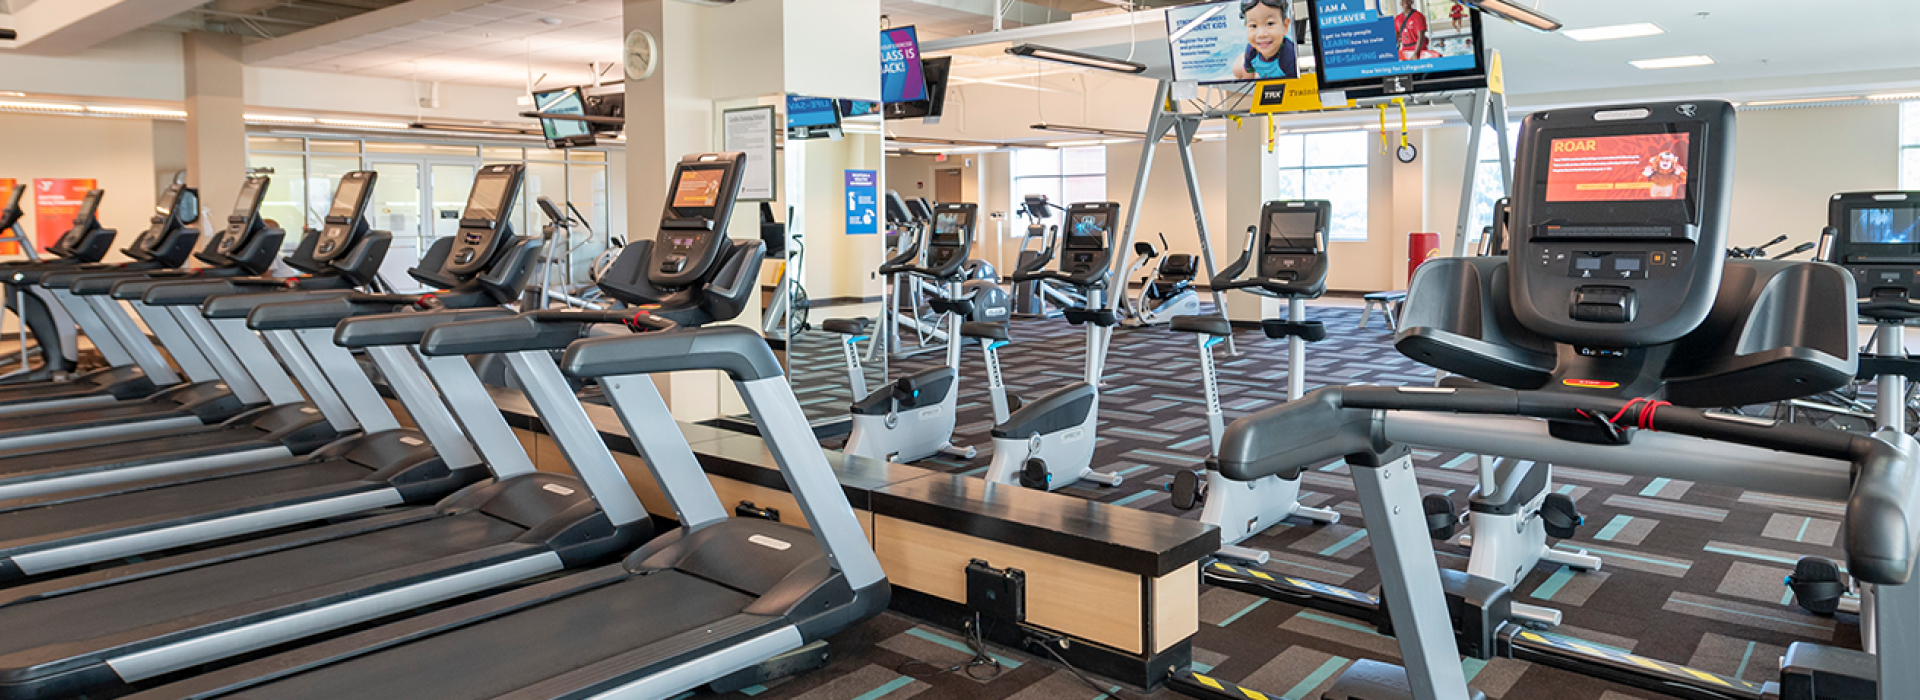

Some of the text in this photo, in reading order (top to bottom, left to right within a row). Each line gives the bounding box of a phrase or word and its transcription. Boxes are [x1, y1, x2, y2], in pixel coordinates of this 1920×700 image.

[1325, 5, 1338, 13] AM
[1340, 3, 1347, 11] A
[1320, 12, 1366, 26] LIFESAVER
[1212, 21, 1227, 30] KIDS
[1354, 29, 1372, 38] people
[1323, 38, 1350, 48] LEARN
[881, 48, 915, 61] LASS IS
[1334, 47, 1355, 55] develop
[1325, 51, 1377, 65] LIFE-SAVING
[881, 61, 905, 73] ACK!
[1374, 66, 1391, 74] hiring
[1288, 88, 1318, 97] Traini
[1554, 140, 1596, 152] ROAR
